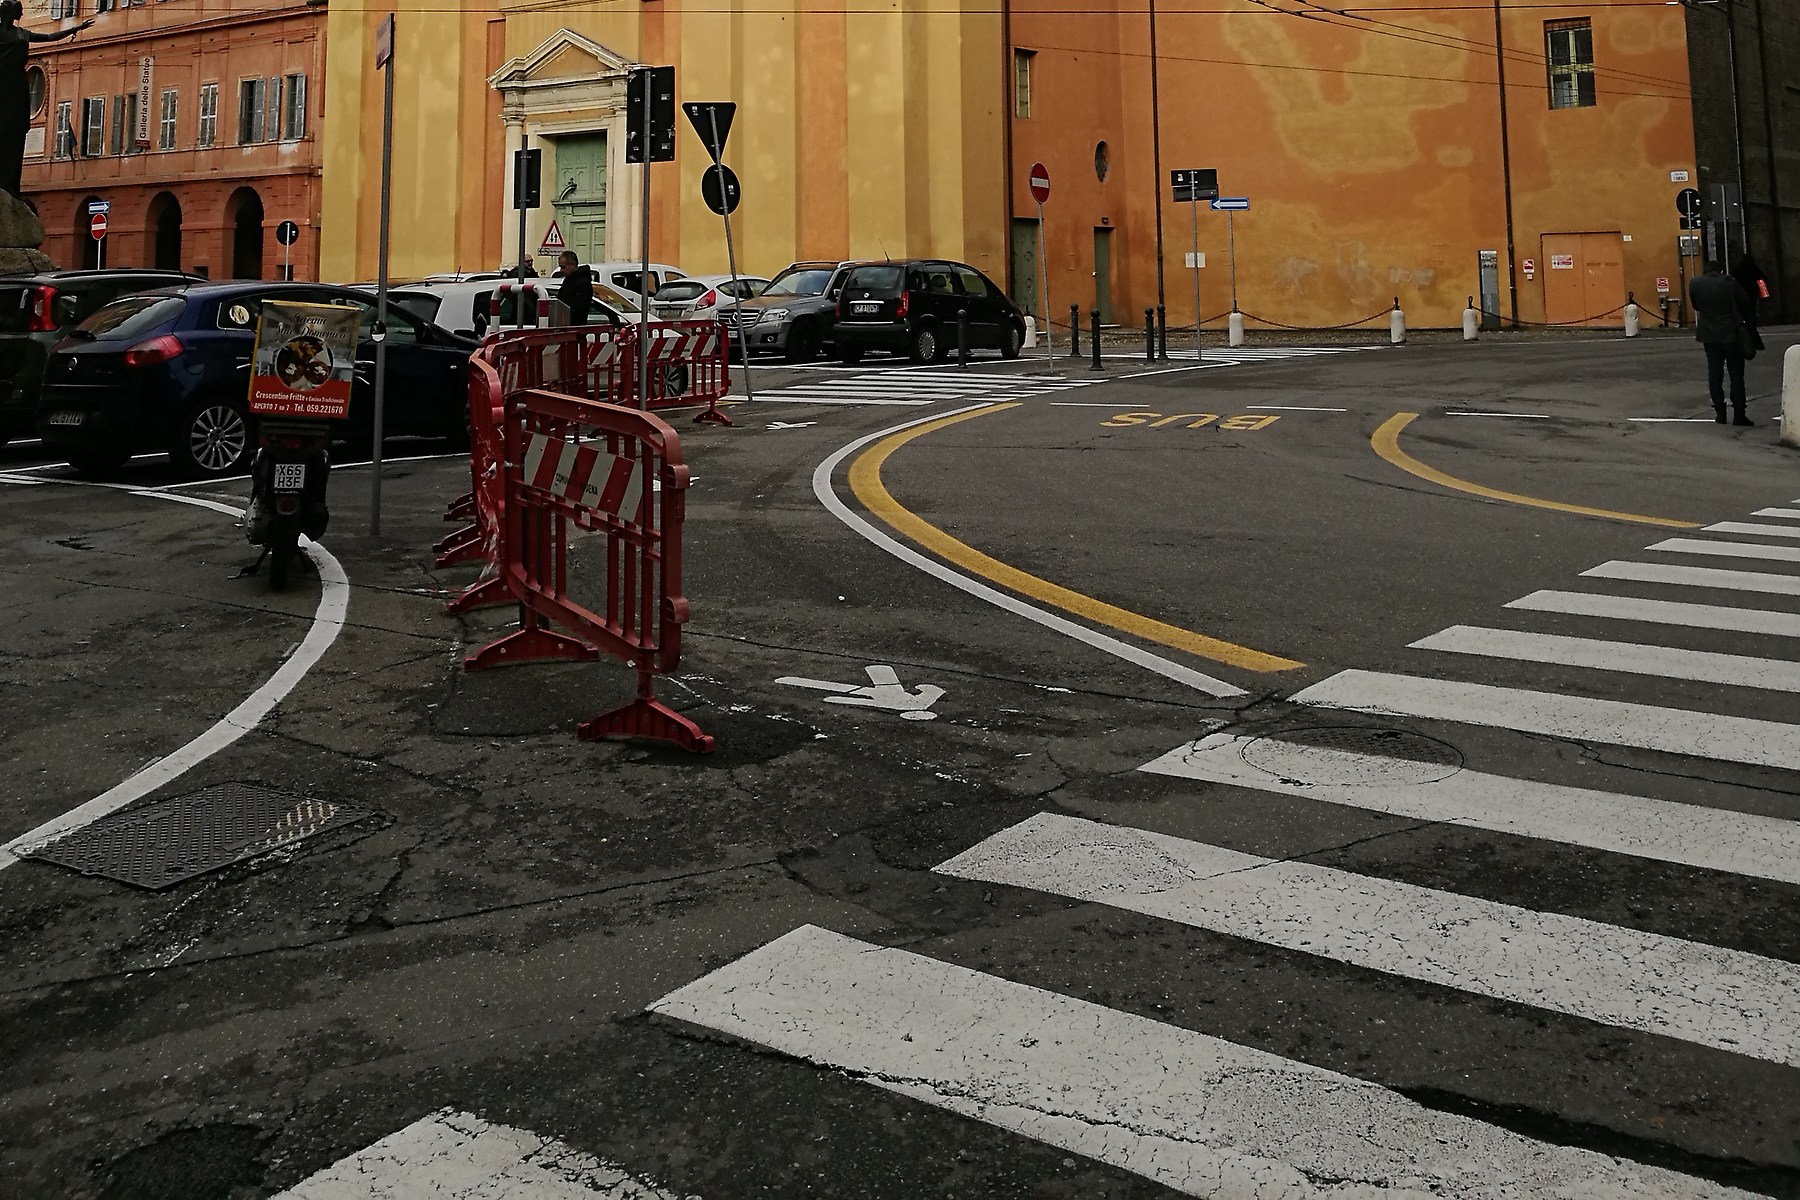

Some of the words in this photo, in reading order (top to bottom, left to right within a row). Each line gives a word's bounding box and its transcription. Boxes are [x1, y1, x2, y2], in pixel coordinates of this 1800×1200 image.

[256, 390, 289, 400] Crescentine
[290, 392, 305, 401] Fritte
[294, 404, 304, 412] Tel.
[1100, 412, 1281, 430] BUS
[278, 476, 301, 487] H3F
